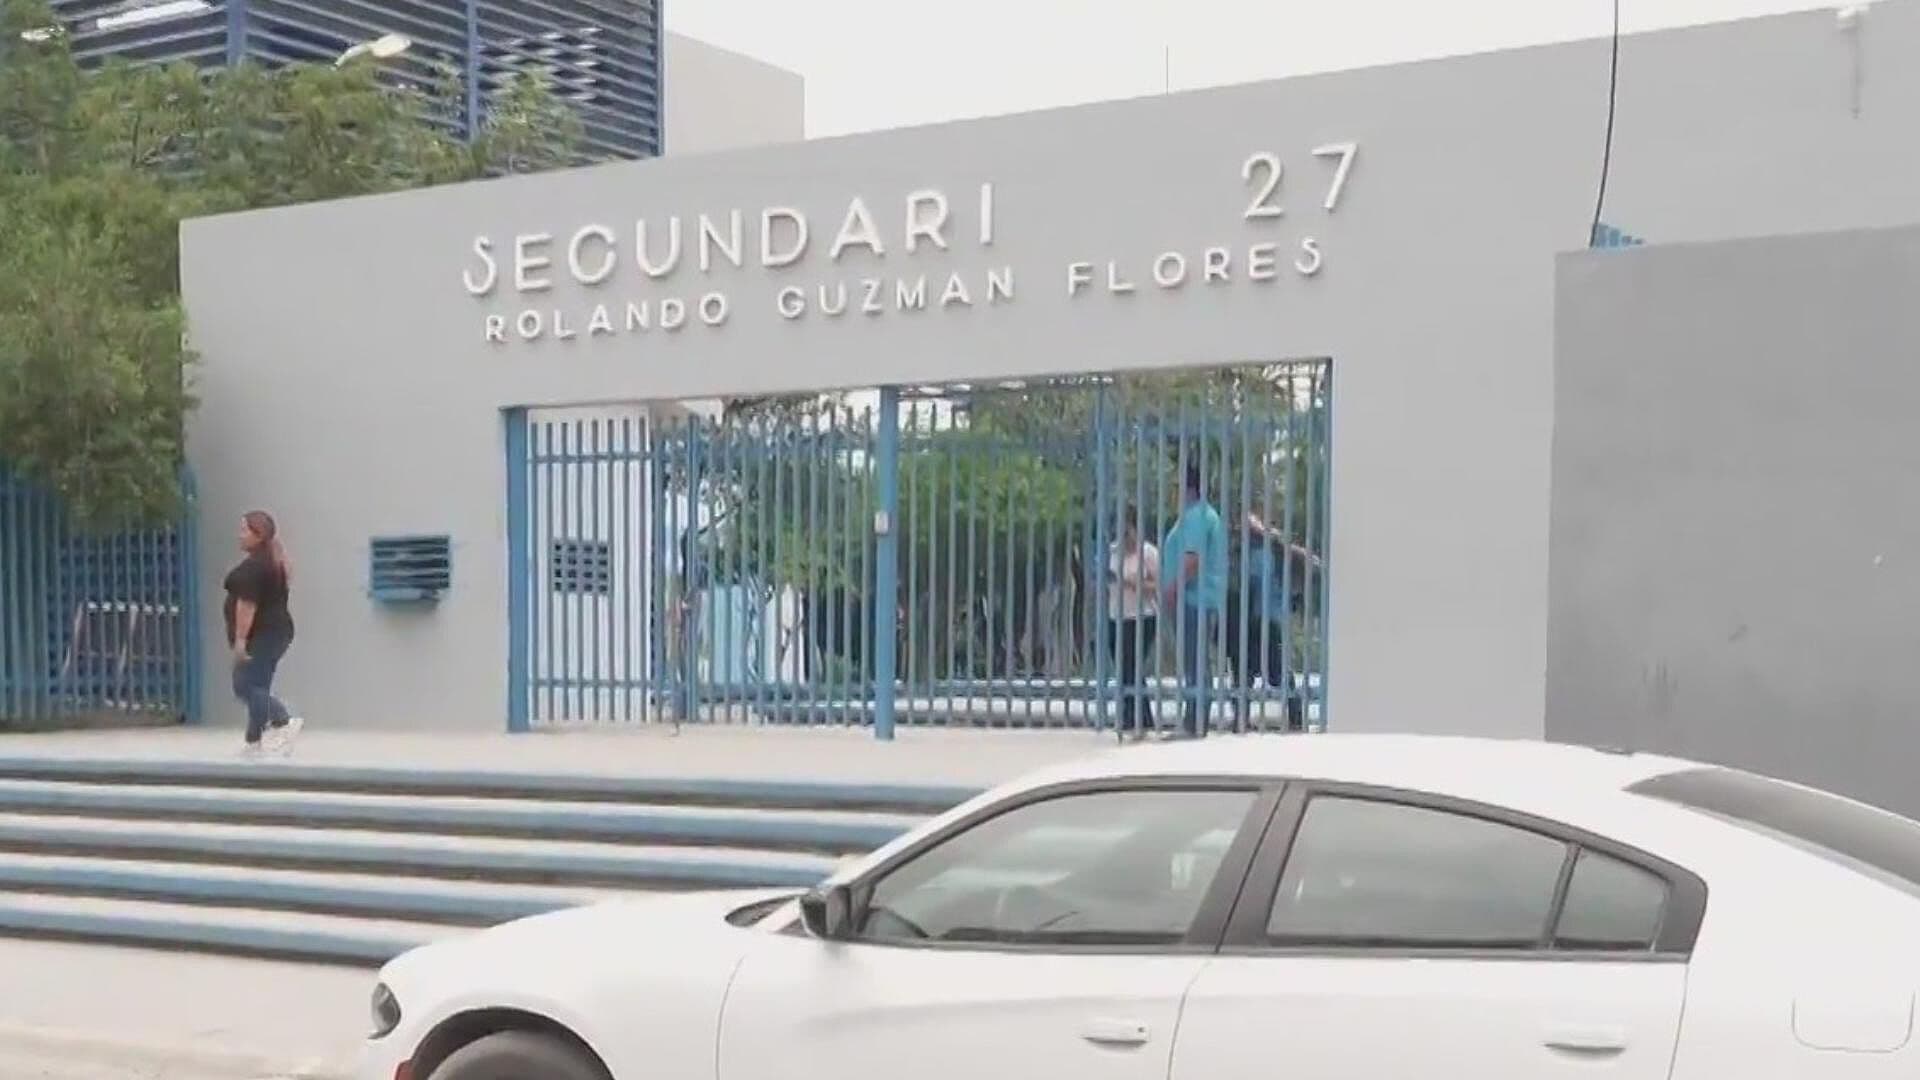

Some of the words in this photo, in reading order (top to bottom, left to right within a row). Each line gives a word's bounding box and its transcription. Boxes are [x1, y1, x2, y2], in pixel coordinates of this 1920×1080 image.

[463, 182, 995, 296] SECUNDARI
[1241, 142, 1359, 219] 27
[485, 292, 730, 342] ROLANDO
[776, 265, 1015, 319] GUZMAN
[1067, 237, 1323, 297] FLORES
